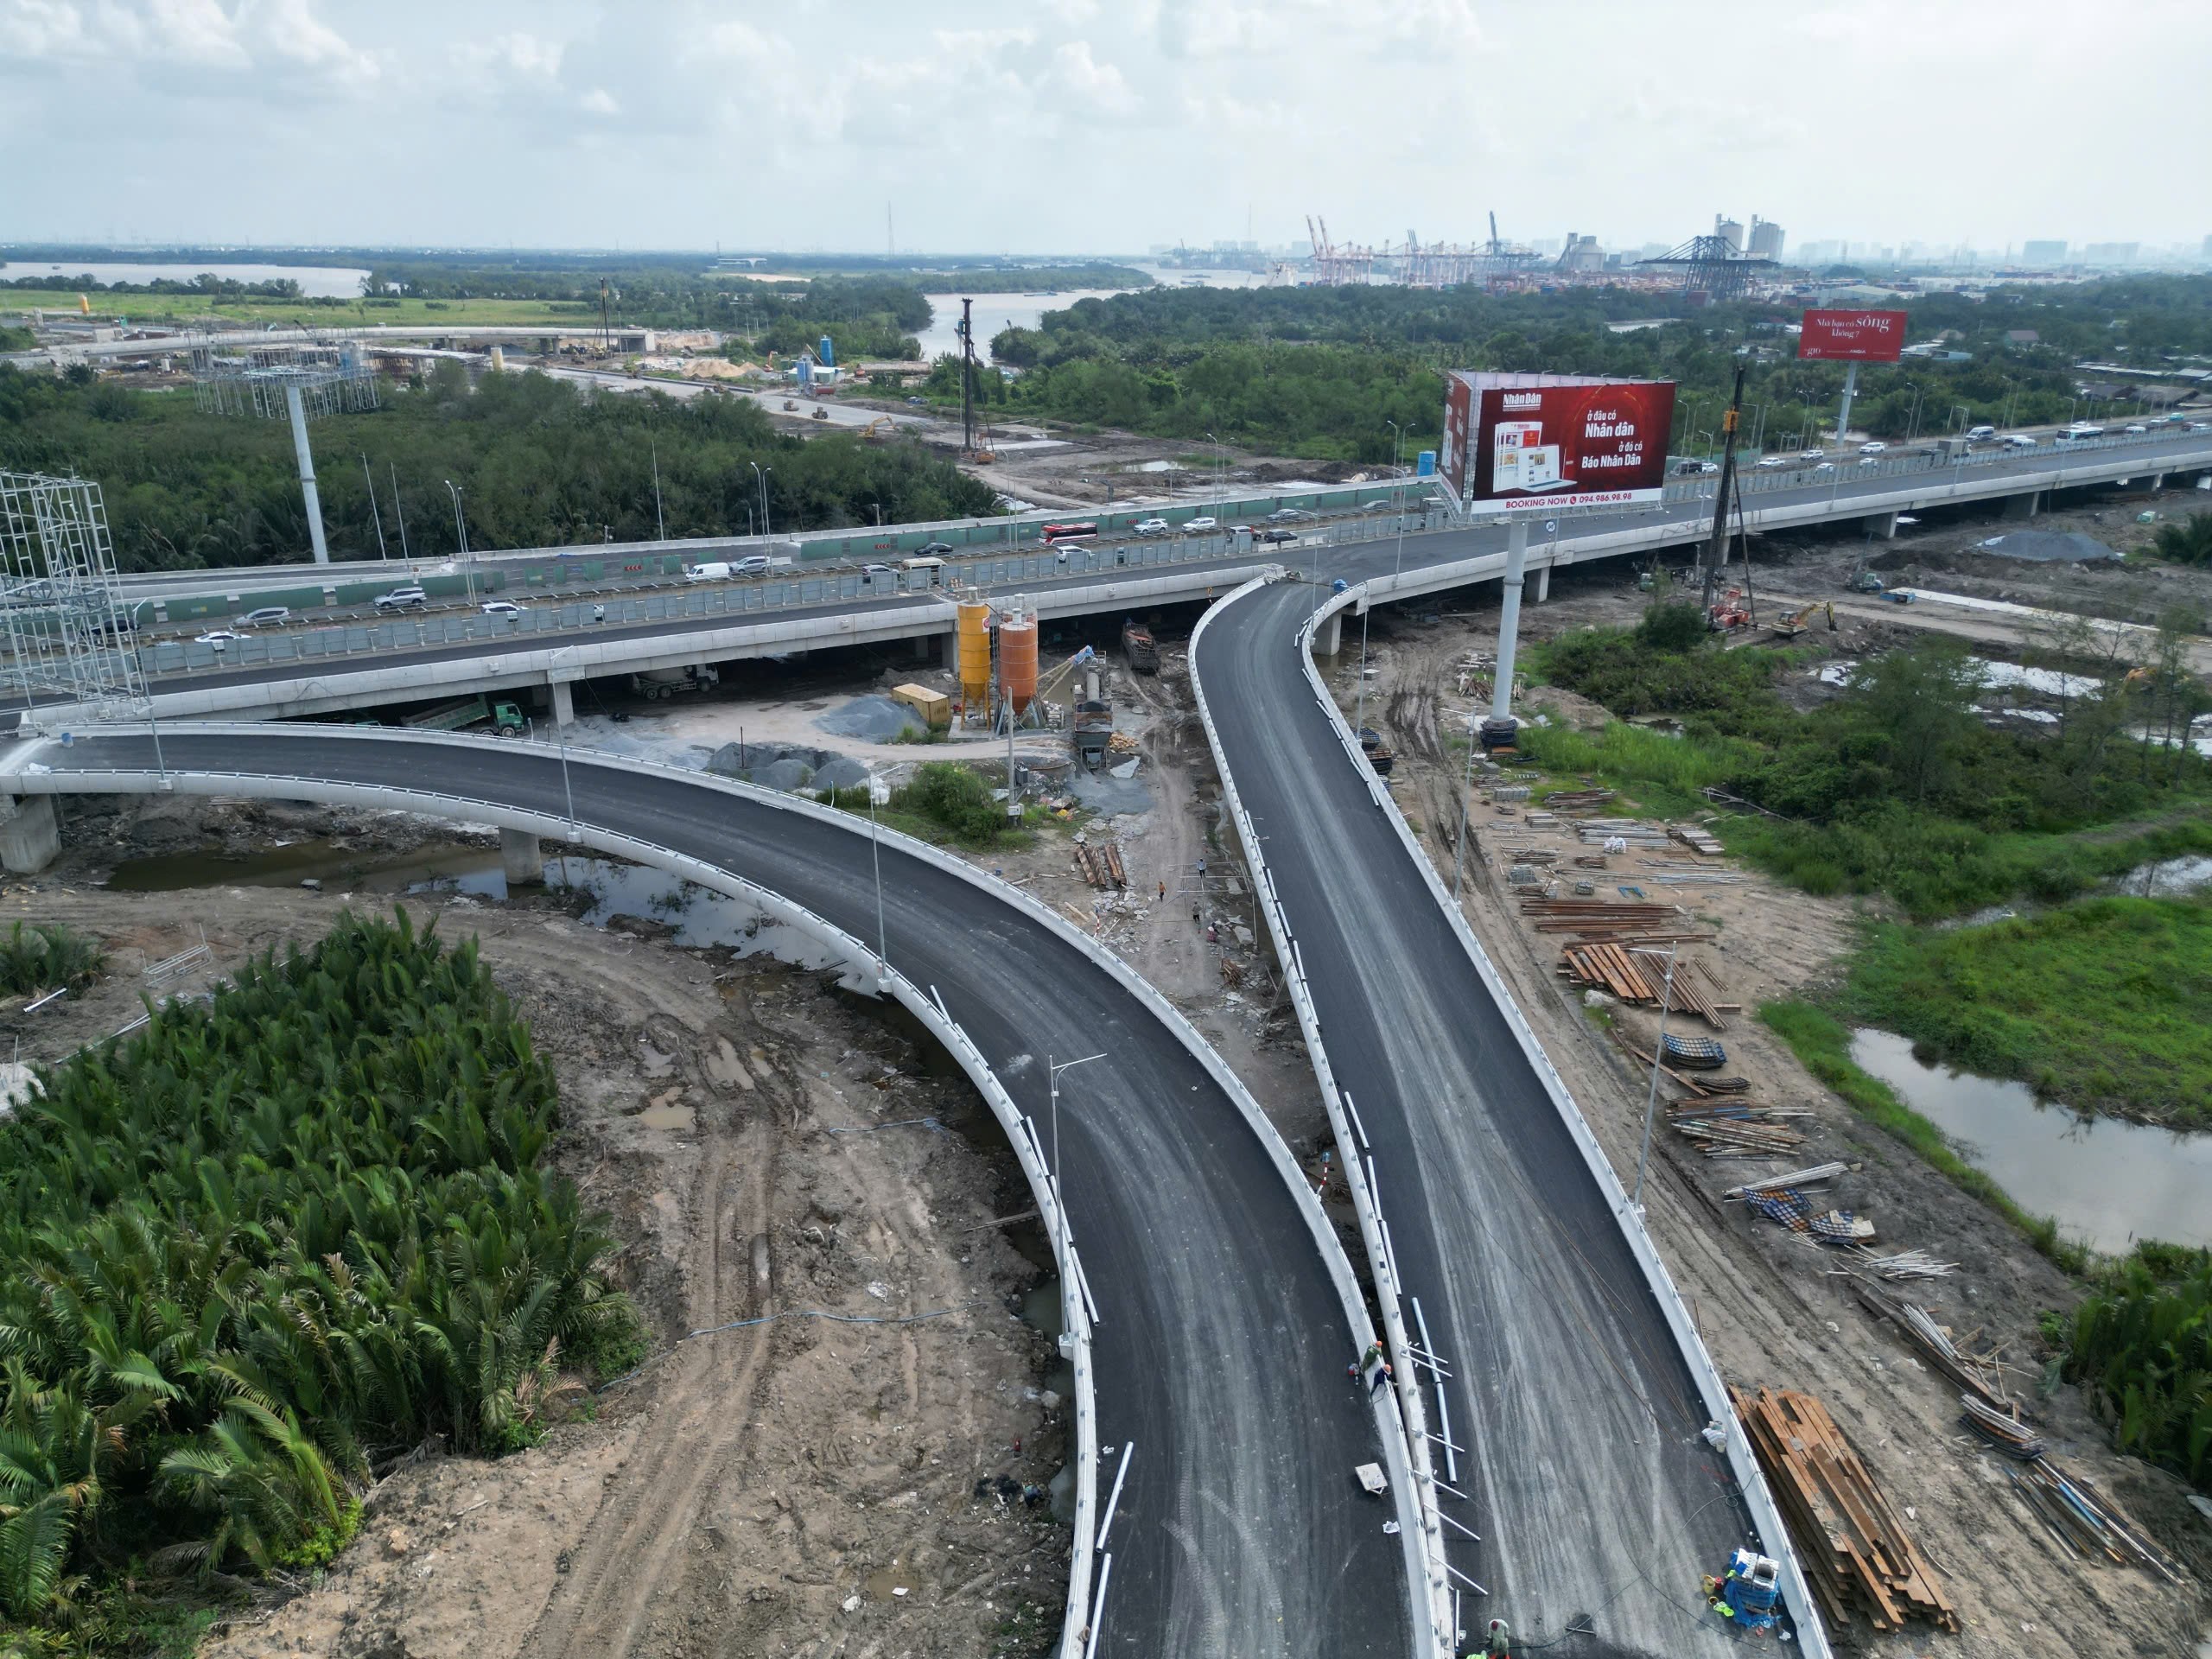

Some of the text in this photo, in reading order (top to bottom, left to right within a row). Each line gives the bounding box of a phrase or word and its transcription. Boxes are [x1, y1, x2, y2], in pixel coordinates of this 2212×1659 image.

[1856, 315, 1891, 334] sông
[1587, 410, 1616, 422] ở đâu có
[1585, 421, 1634, 438] Nhân dân
[1618, 440, 1643, 452] ở đó có
[1581, 453, 1641, 469] Báo Nhân Dân
[1505, 493, 1632, 509] BOOKING NOW 094.986.98.98
